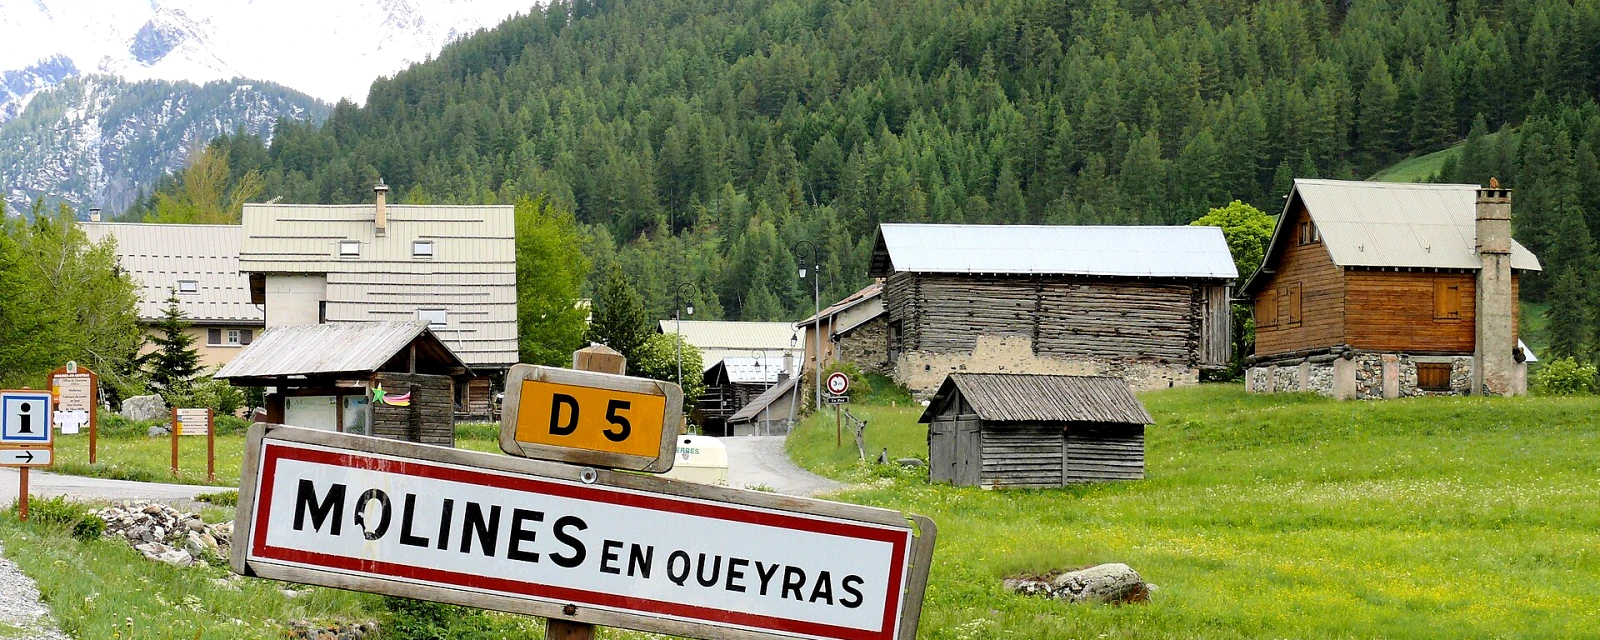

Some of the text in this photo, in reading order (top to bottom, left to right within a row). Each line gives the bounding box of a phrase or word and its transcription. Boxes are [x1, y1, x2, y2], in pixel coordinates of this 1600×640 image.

[549, 393, 631, 442] D 5
[293, 479, 865, 608] MOLINES EN QUEYRAS
